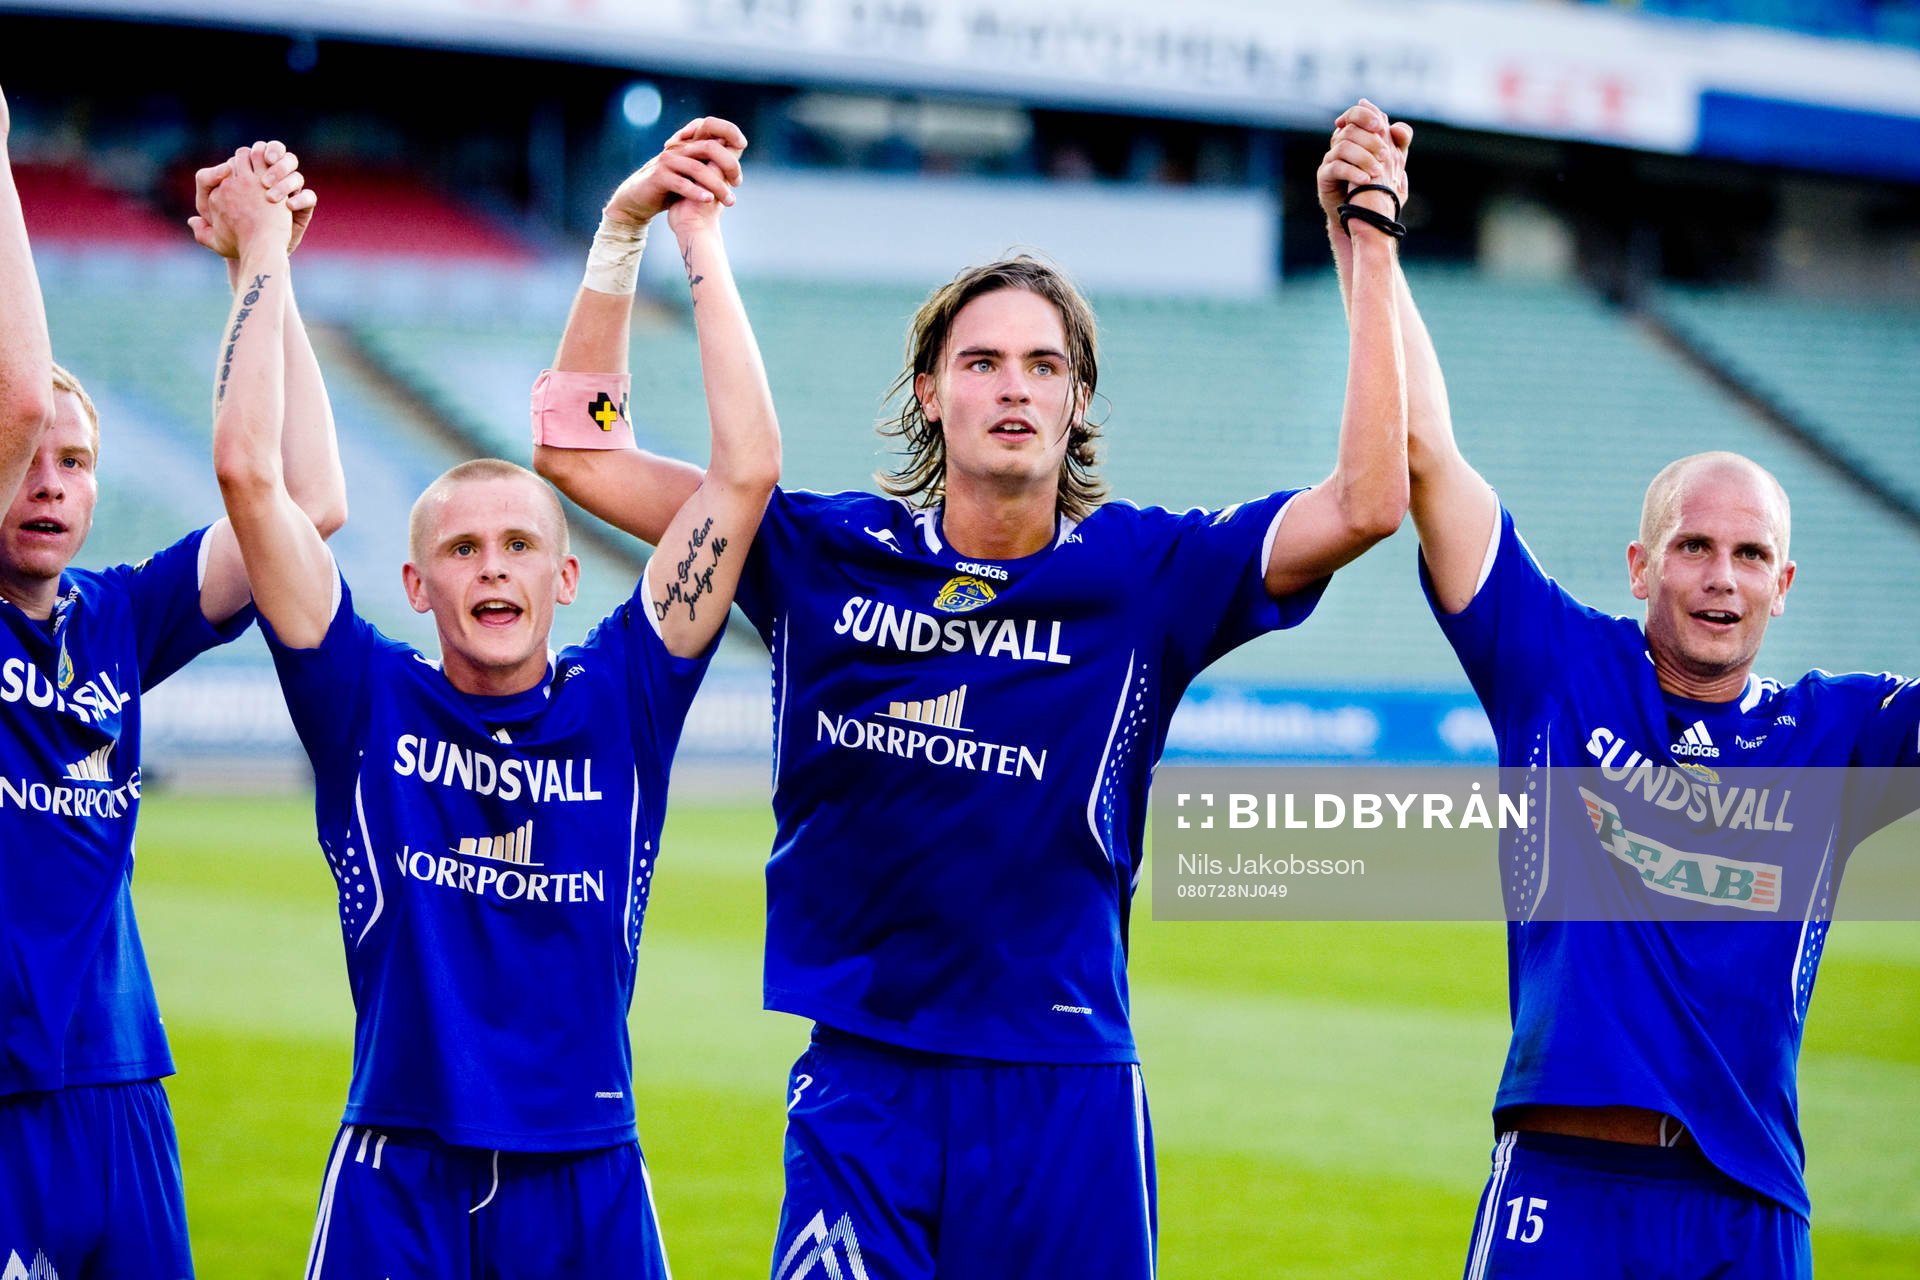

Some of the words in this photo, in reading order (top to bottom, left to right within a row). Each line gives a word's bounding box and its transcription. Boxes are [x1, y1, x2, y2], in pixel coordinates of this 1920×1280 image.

[955, 561, 1009, 581] adidas
[834, 596, 1071, 665] SUNDSVALL
[393, 734, 603, 803] SUNDSVALL
[817, 710, 1047, 781] NORRPORTEN
[1670, 743, 1720, 758] adidas
[0, 766, 141, 818] NORRPORTE
[1586, 727, 1794, 832] SUNDSVALL
[396, 845, 605, 903] NORRPORTEN
[1600, 807, 1755, 901] PEAB
[354, 1129, 388, 1169] 11
[1506, 1195, 1548, 1244] 15
